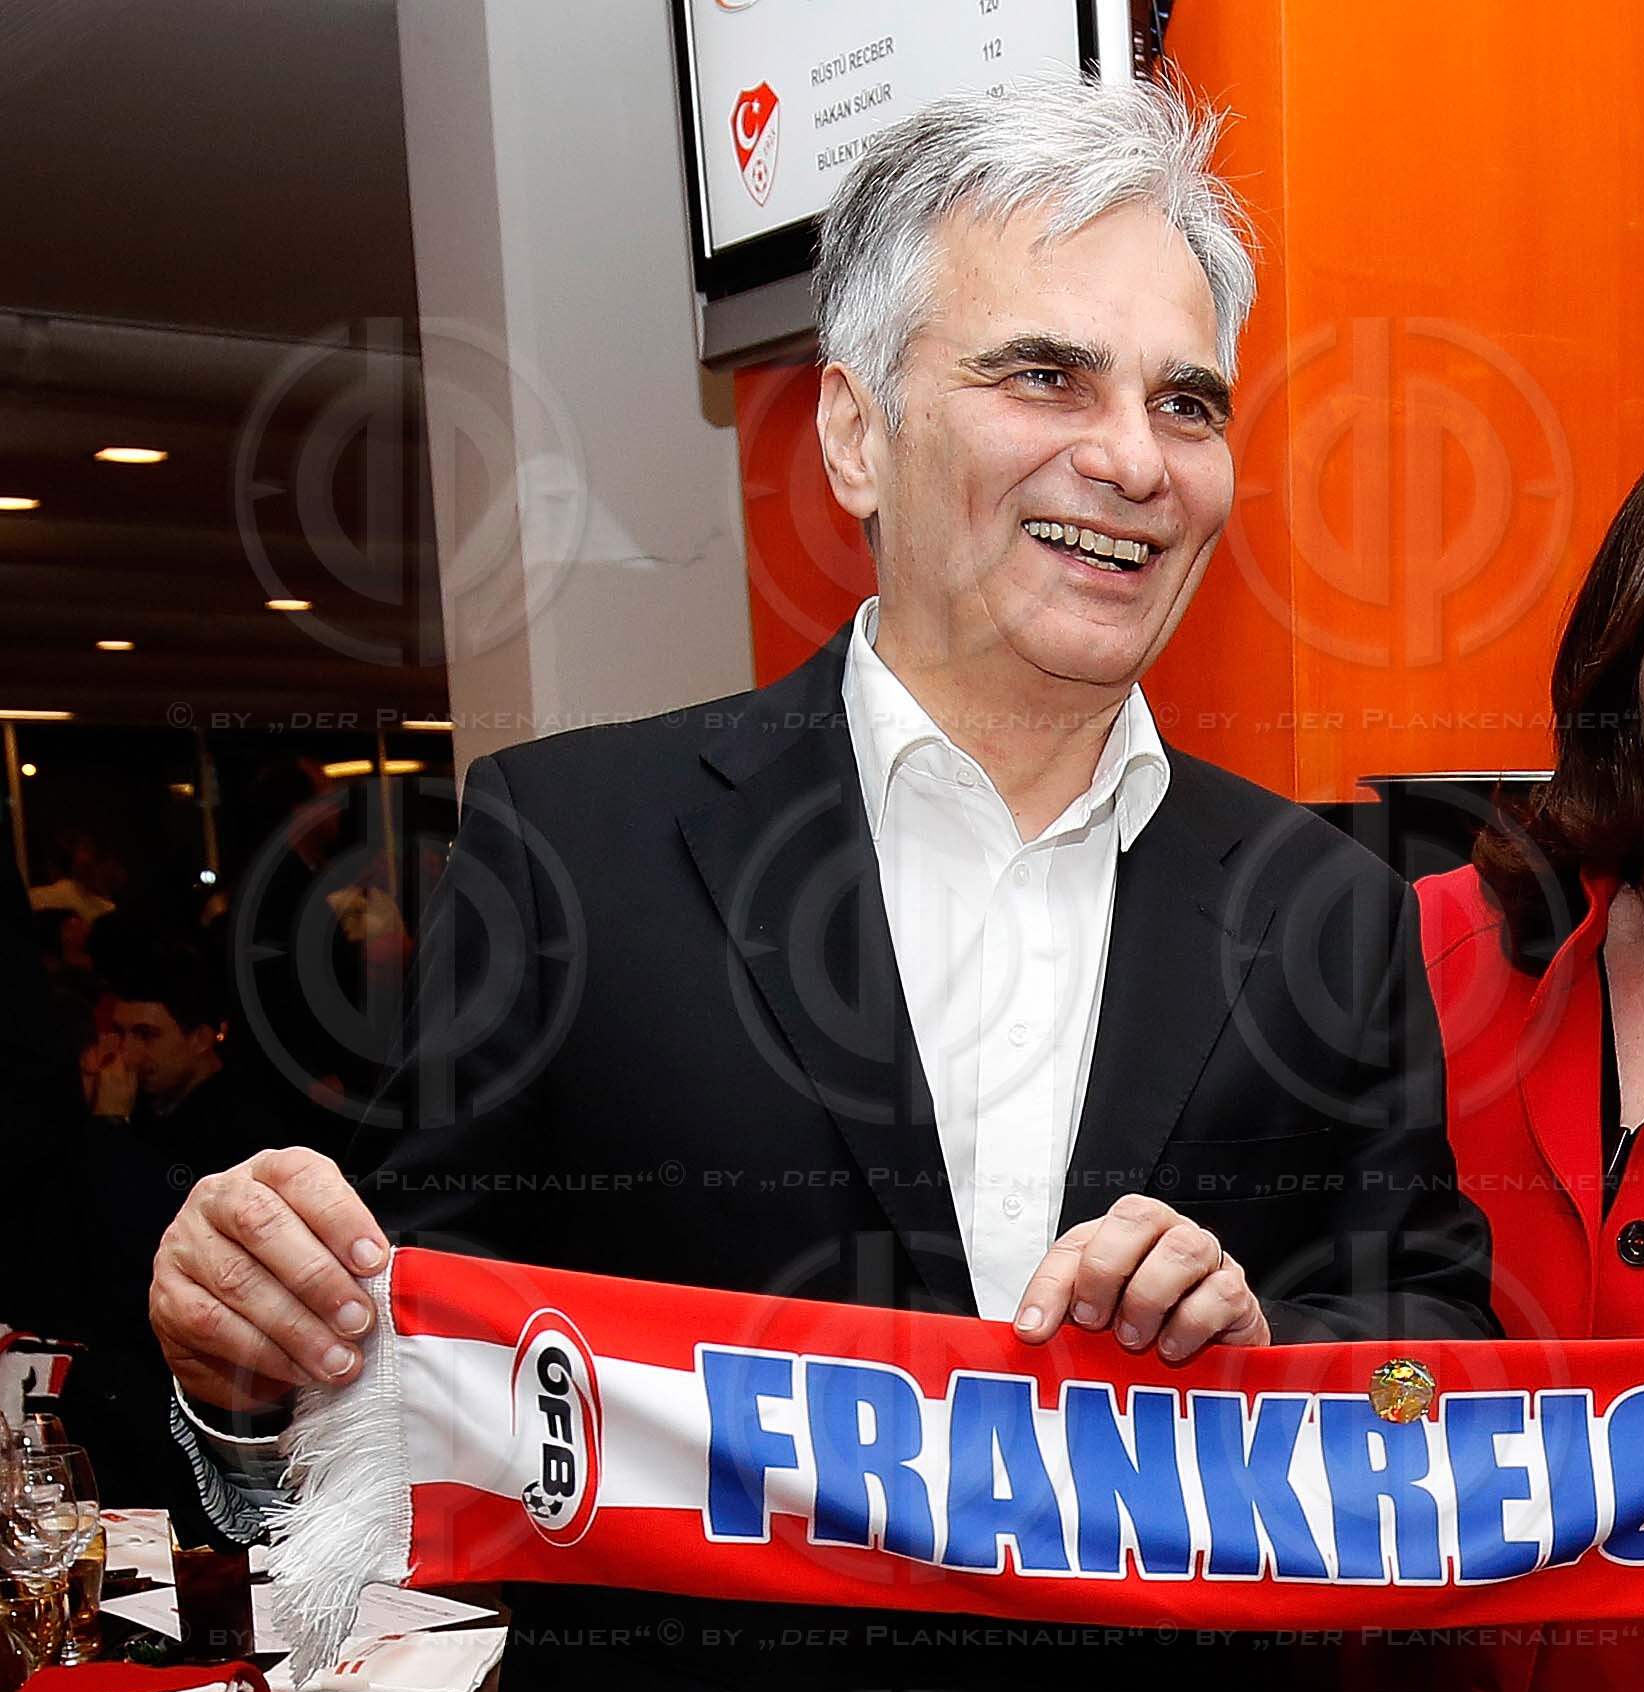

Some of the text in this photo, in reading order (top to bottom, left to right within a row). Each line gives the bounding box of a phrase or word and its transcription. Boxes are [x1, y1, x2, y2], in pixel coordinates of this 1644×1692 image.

[849, 36, 895, 70] RECBER
[814, 38, 1003, 129] HAKAN SÜKÜR 112
[816, 138, 861, 171] BÜLENT
